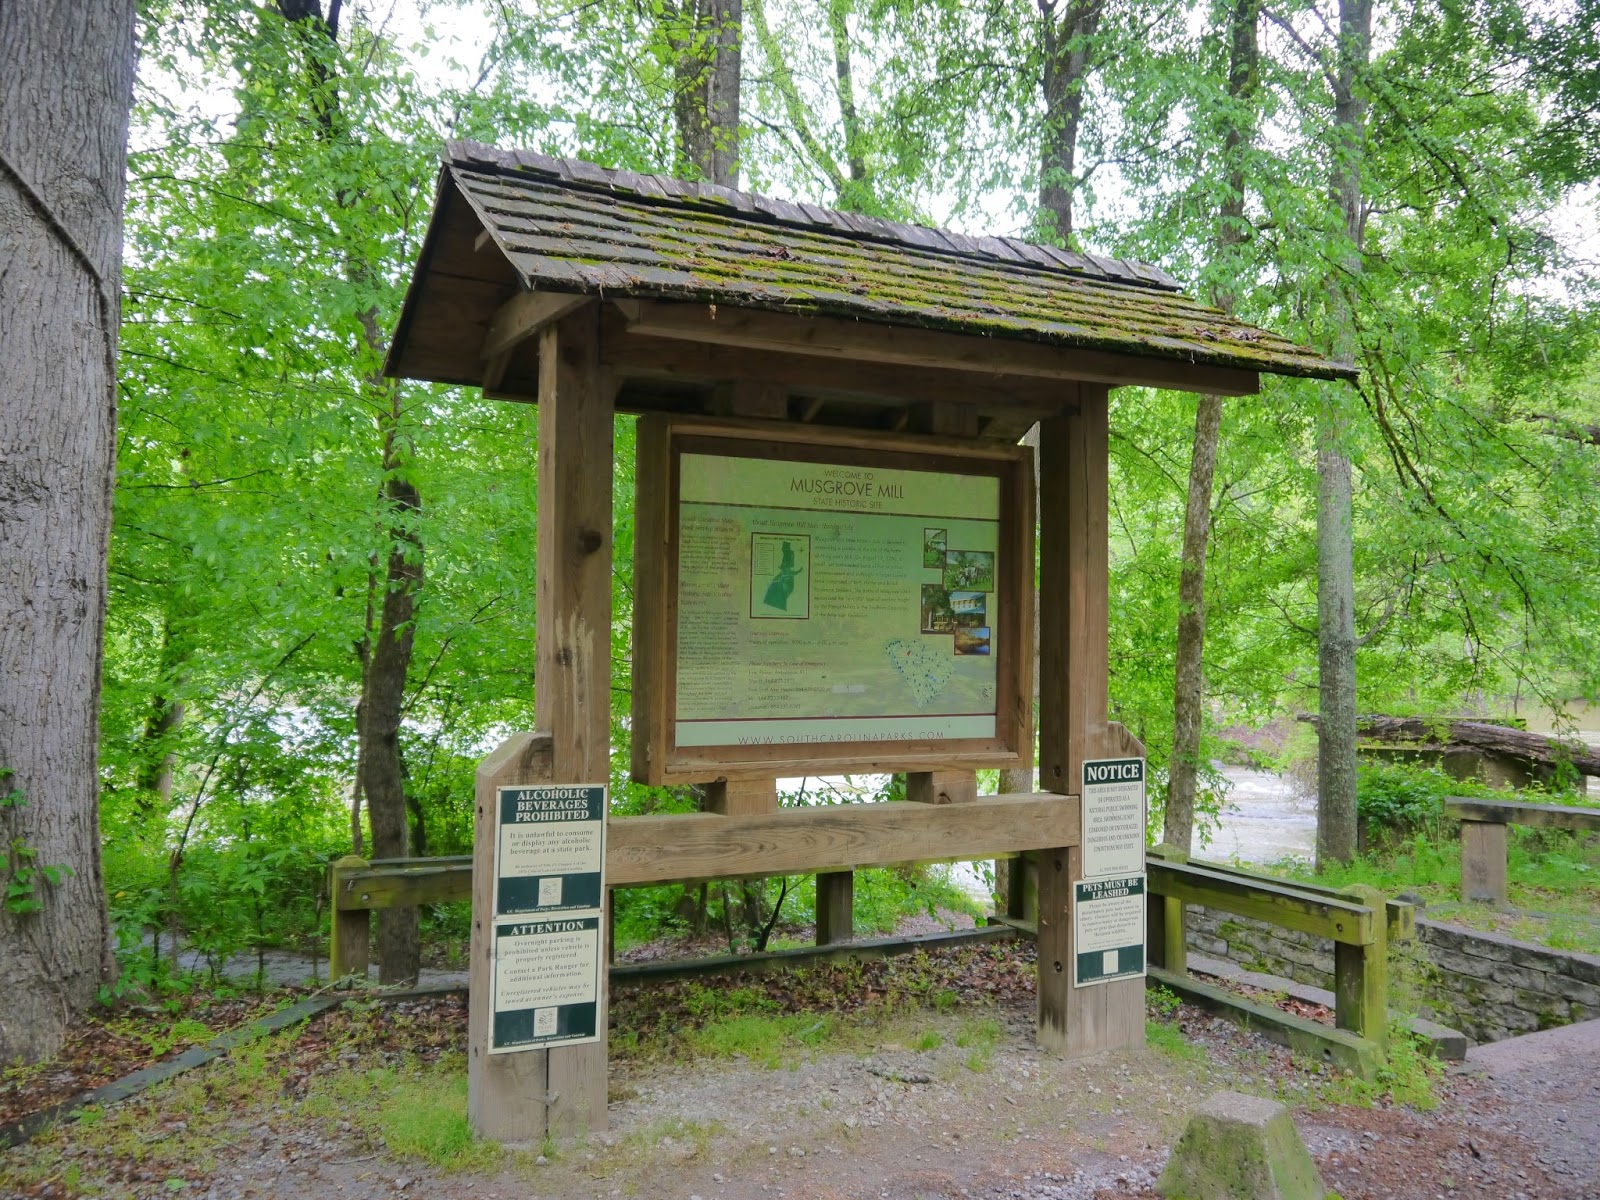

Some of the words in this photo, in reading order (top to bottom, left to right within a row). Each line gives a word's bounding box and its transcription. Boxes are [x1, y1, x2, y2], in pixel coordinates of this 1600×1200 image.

[824, 470, 861, 480] WELCOME
[864, 472, 874, 480] TO
[790, 477, 872, 496] MUSGROVE
[878, 485, 904, 499] MILL
[813, 497, 833, 506] STATE
[835, 499, 867, 508] HISTORIC
[870, 501, 883, 509] SITE
[1087, 764, 1139, 781] NOTICE
[517, 789, 588, 800] ALCOHOLIC
[517, 800, 588, 811] BEVERAGES
[515, 810, 589, 822] PROHIBITED
[521, 840, 545, 848] display
[574, 845, 592, 853] park.
[1082, 883, 1103, 892] PETS
[1104, 879, 1126, 889] MUST
[1128, 878, 1139, 887] BE
[1092, 888, 1129, 900] LEASHED
[511, 921, 584, 936] ATTENTION
[514, 939, 548, 947] Overnight
[549, 937, 574, 945] parking
[504, 948, 538, 956] prohibited
[515, 956, 543, 964] properly
[510, 975, 542, 983] additional
[544, 971, 583, 979] information.
[500, 987, 541, 997] Unregistered
[543, 985, 567, 993] vehicles
